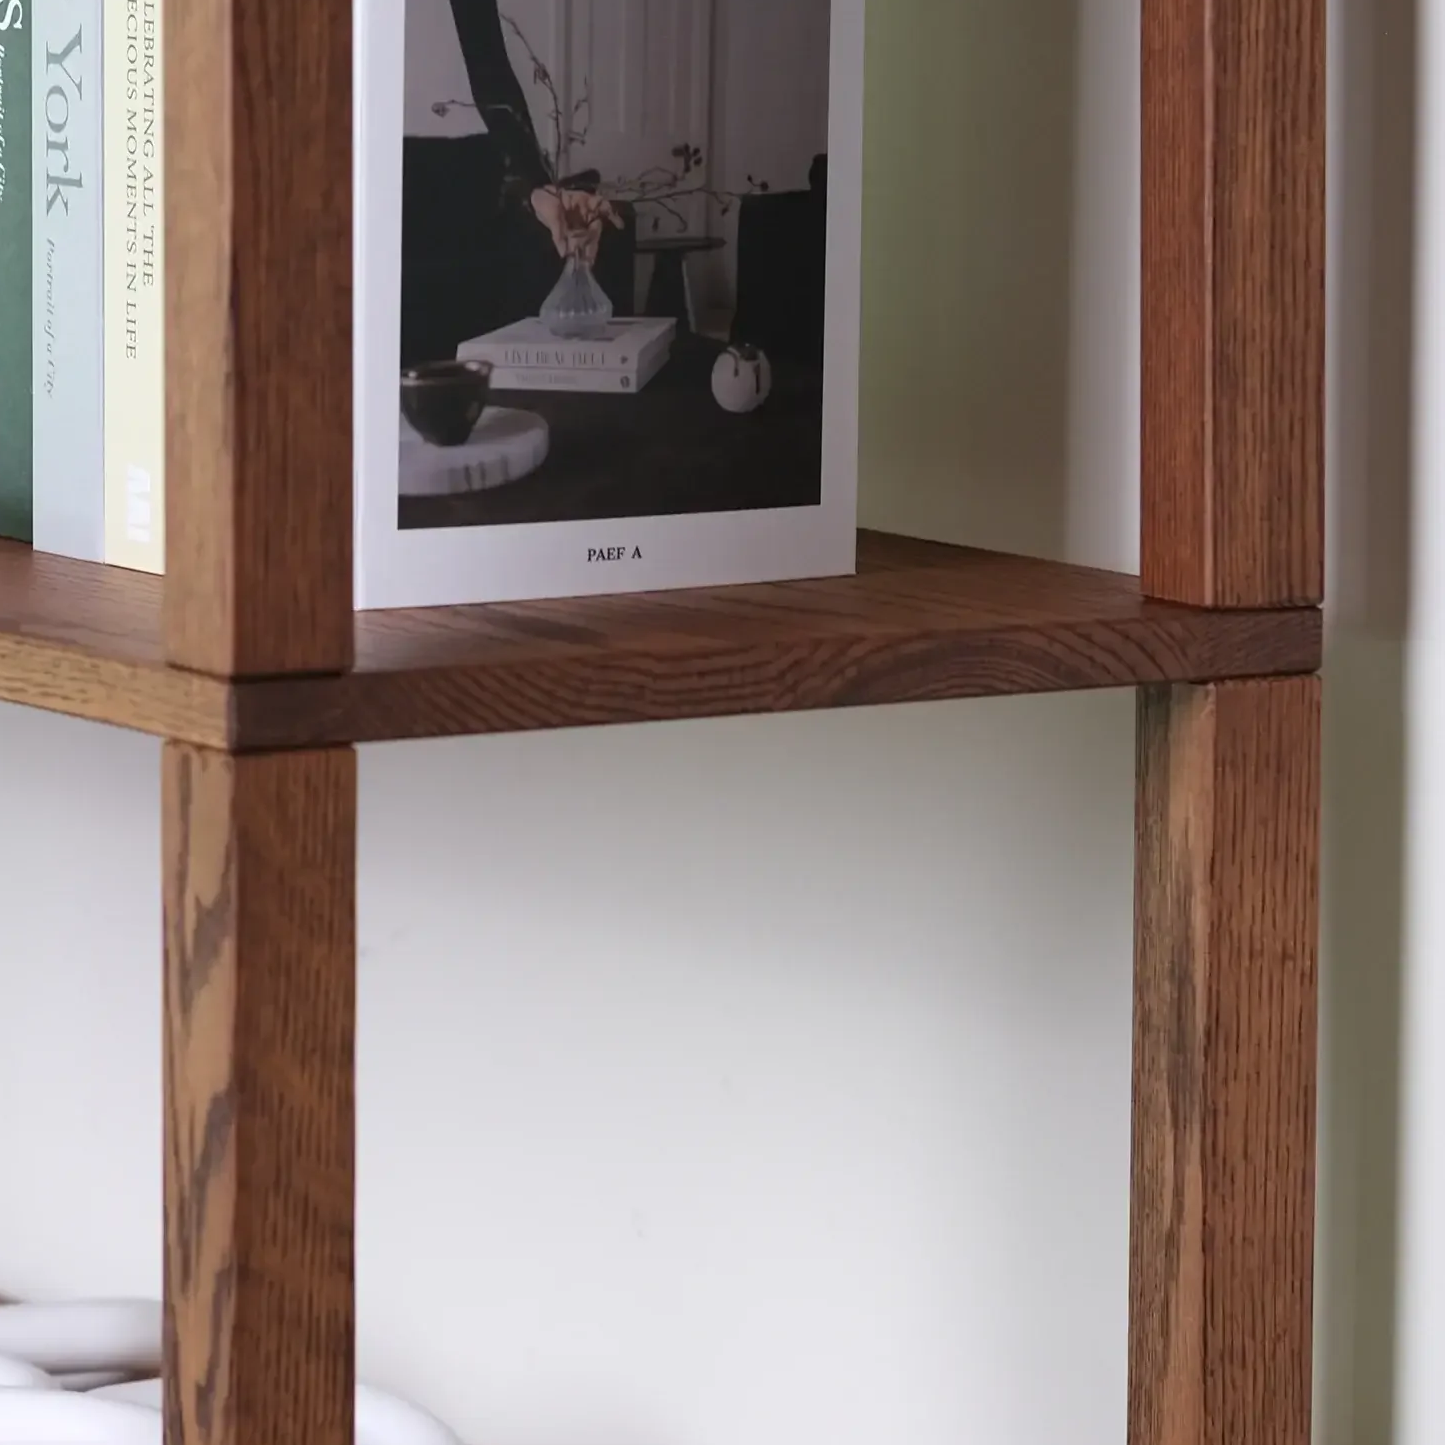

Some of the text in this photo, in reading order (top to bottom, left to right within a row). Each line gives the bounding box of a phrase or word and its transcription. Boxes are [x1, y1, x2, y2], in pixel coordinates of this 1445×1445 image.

[44, 22, 85, 218] York
[126, 108, 138, 254] MOMENTS
[142, 165, 155, 217] ALL
[45, 237, 56, 316] Portrait
[126, 261, 138, 292] IN
[142, 224, 155, 287] THE
[43, 319, 57, 343] of
[126, 300, 137, 359] LIFE
[43, 358, 56, 400] City
[587, 544, 642, 563] PAEF A
